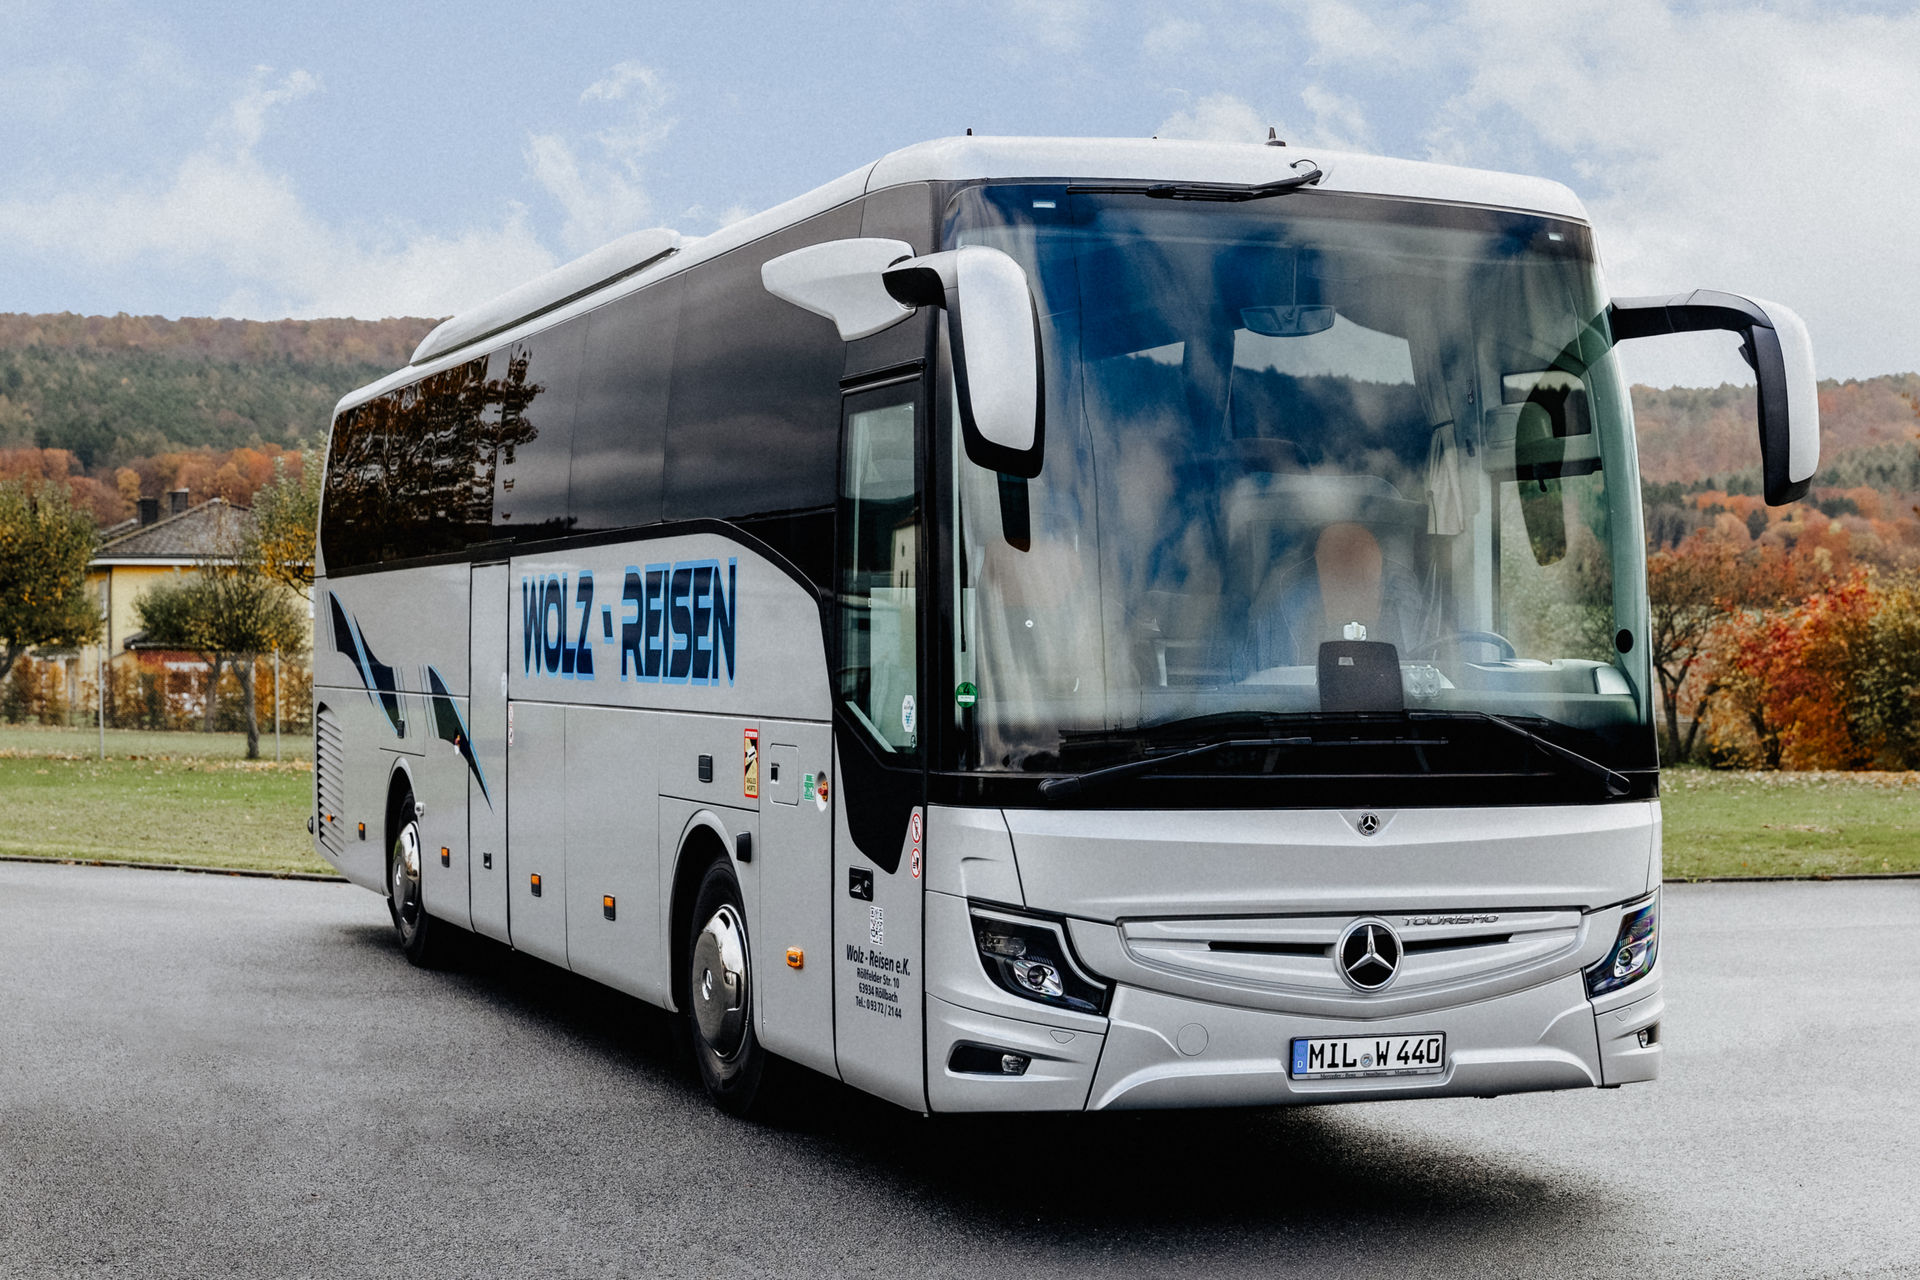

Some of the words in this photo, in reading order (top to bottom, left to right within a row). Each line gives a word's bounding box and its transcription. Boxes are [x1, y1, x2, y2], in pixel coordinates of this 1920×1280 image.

[522, 569, 595, 681] WOLZ
[620, 556, 738, 688] REISEN
[963, 682, 970, 695] 4
[1402, 914, 1499, 926] TOURISMO
[846, 944, 864, 963] Wolz
[869, 950, 894, 971] Reisen
[896, 958, 911, 976] e.K.
[859, 983, 874, 995] 63934
[883, 974, 893, 986] Str.
[893, 977, 900, 989] 10
[1308, 1043, 1357, 1069] MIL
[1376, 1041, 1390, 1066] W
[1396, 1038, 1440, 1065] 440
